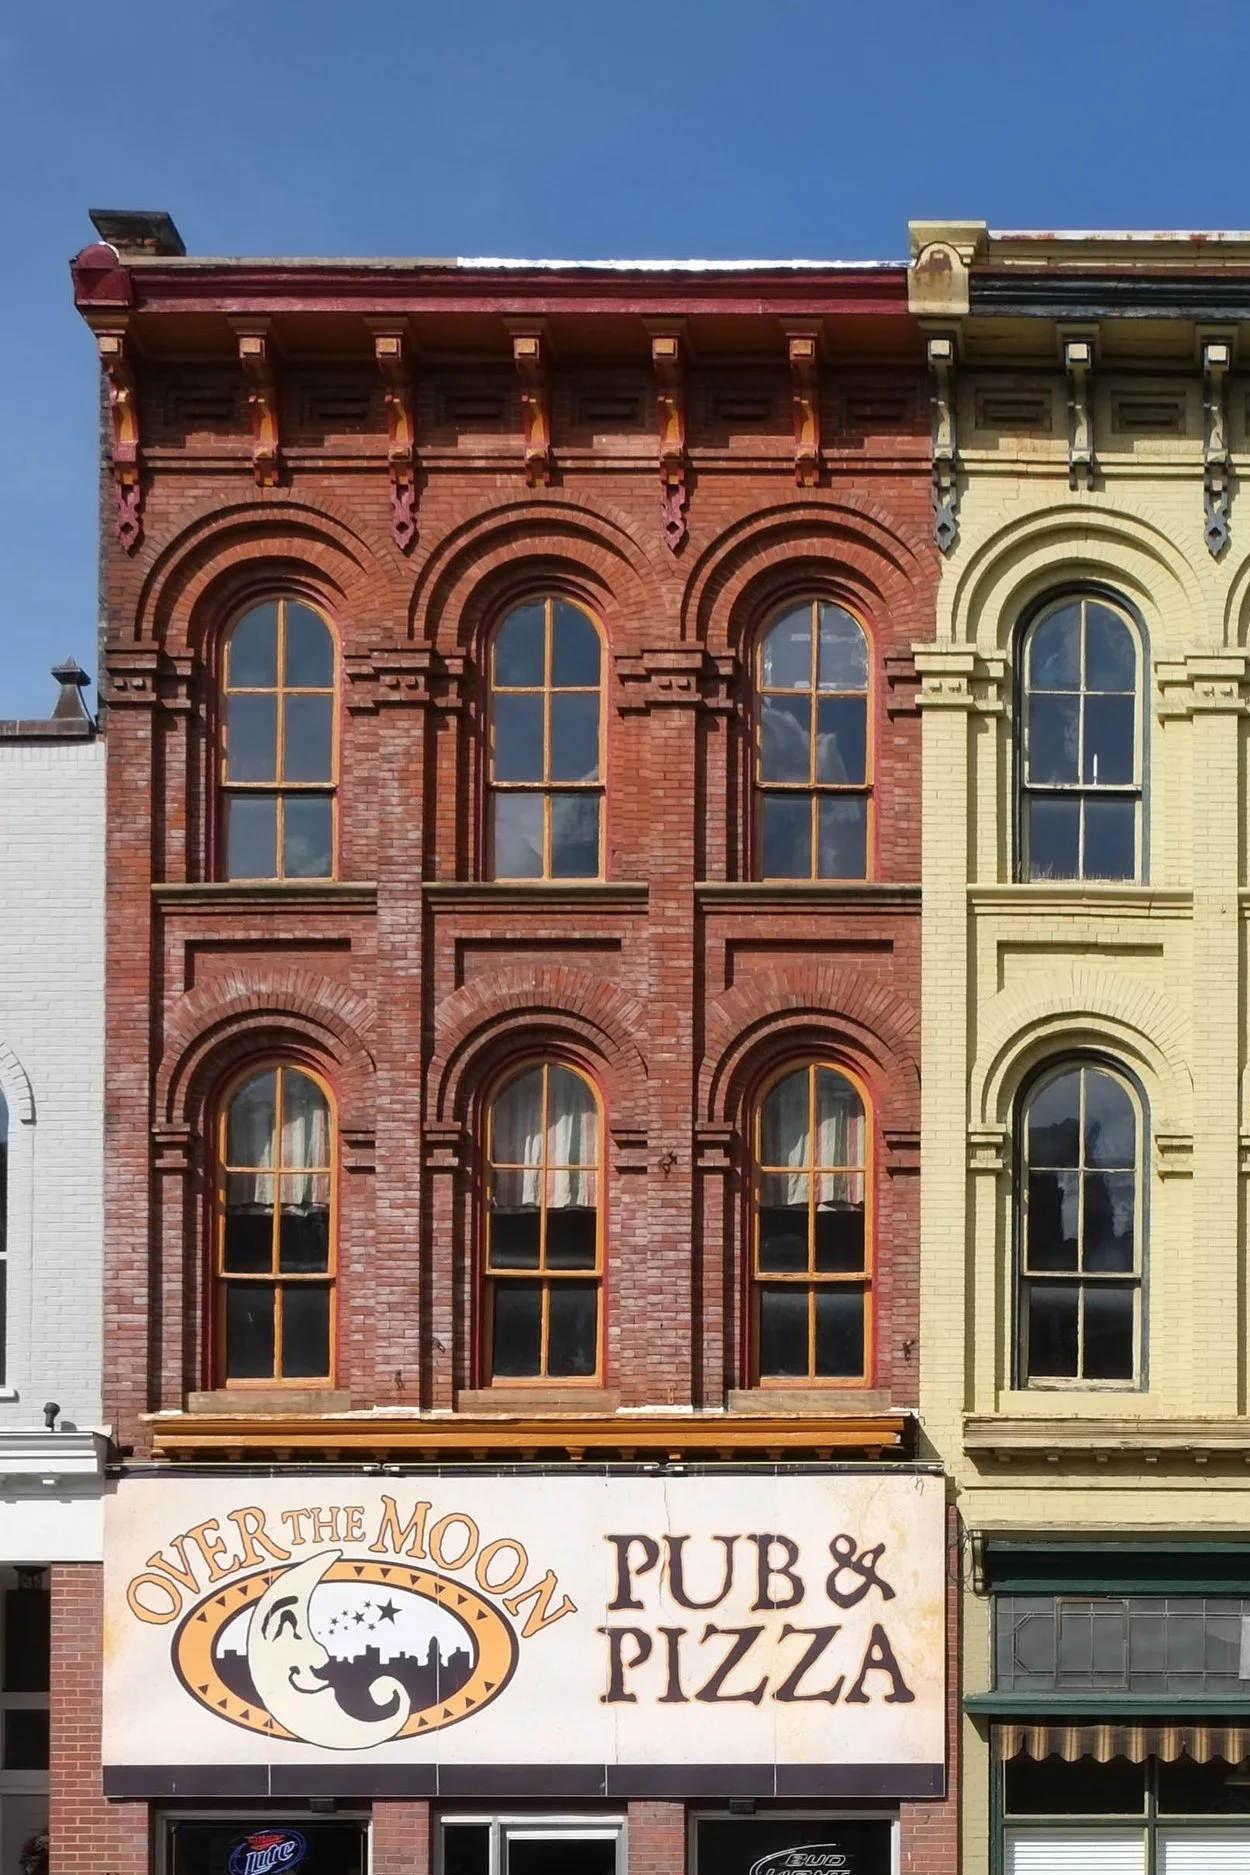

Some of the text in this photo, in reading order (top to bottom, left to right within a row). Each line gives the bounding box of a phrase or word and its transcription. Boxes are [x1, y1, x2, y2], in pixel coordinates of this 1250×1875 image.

[126, 1494, 578, 1639] OVER THE MOON
[604, 1533, 897, 1612] PUB &
[596, 1623, 917, 1706] PIZZA
[785, 1853, 847, 1866] BUD
